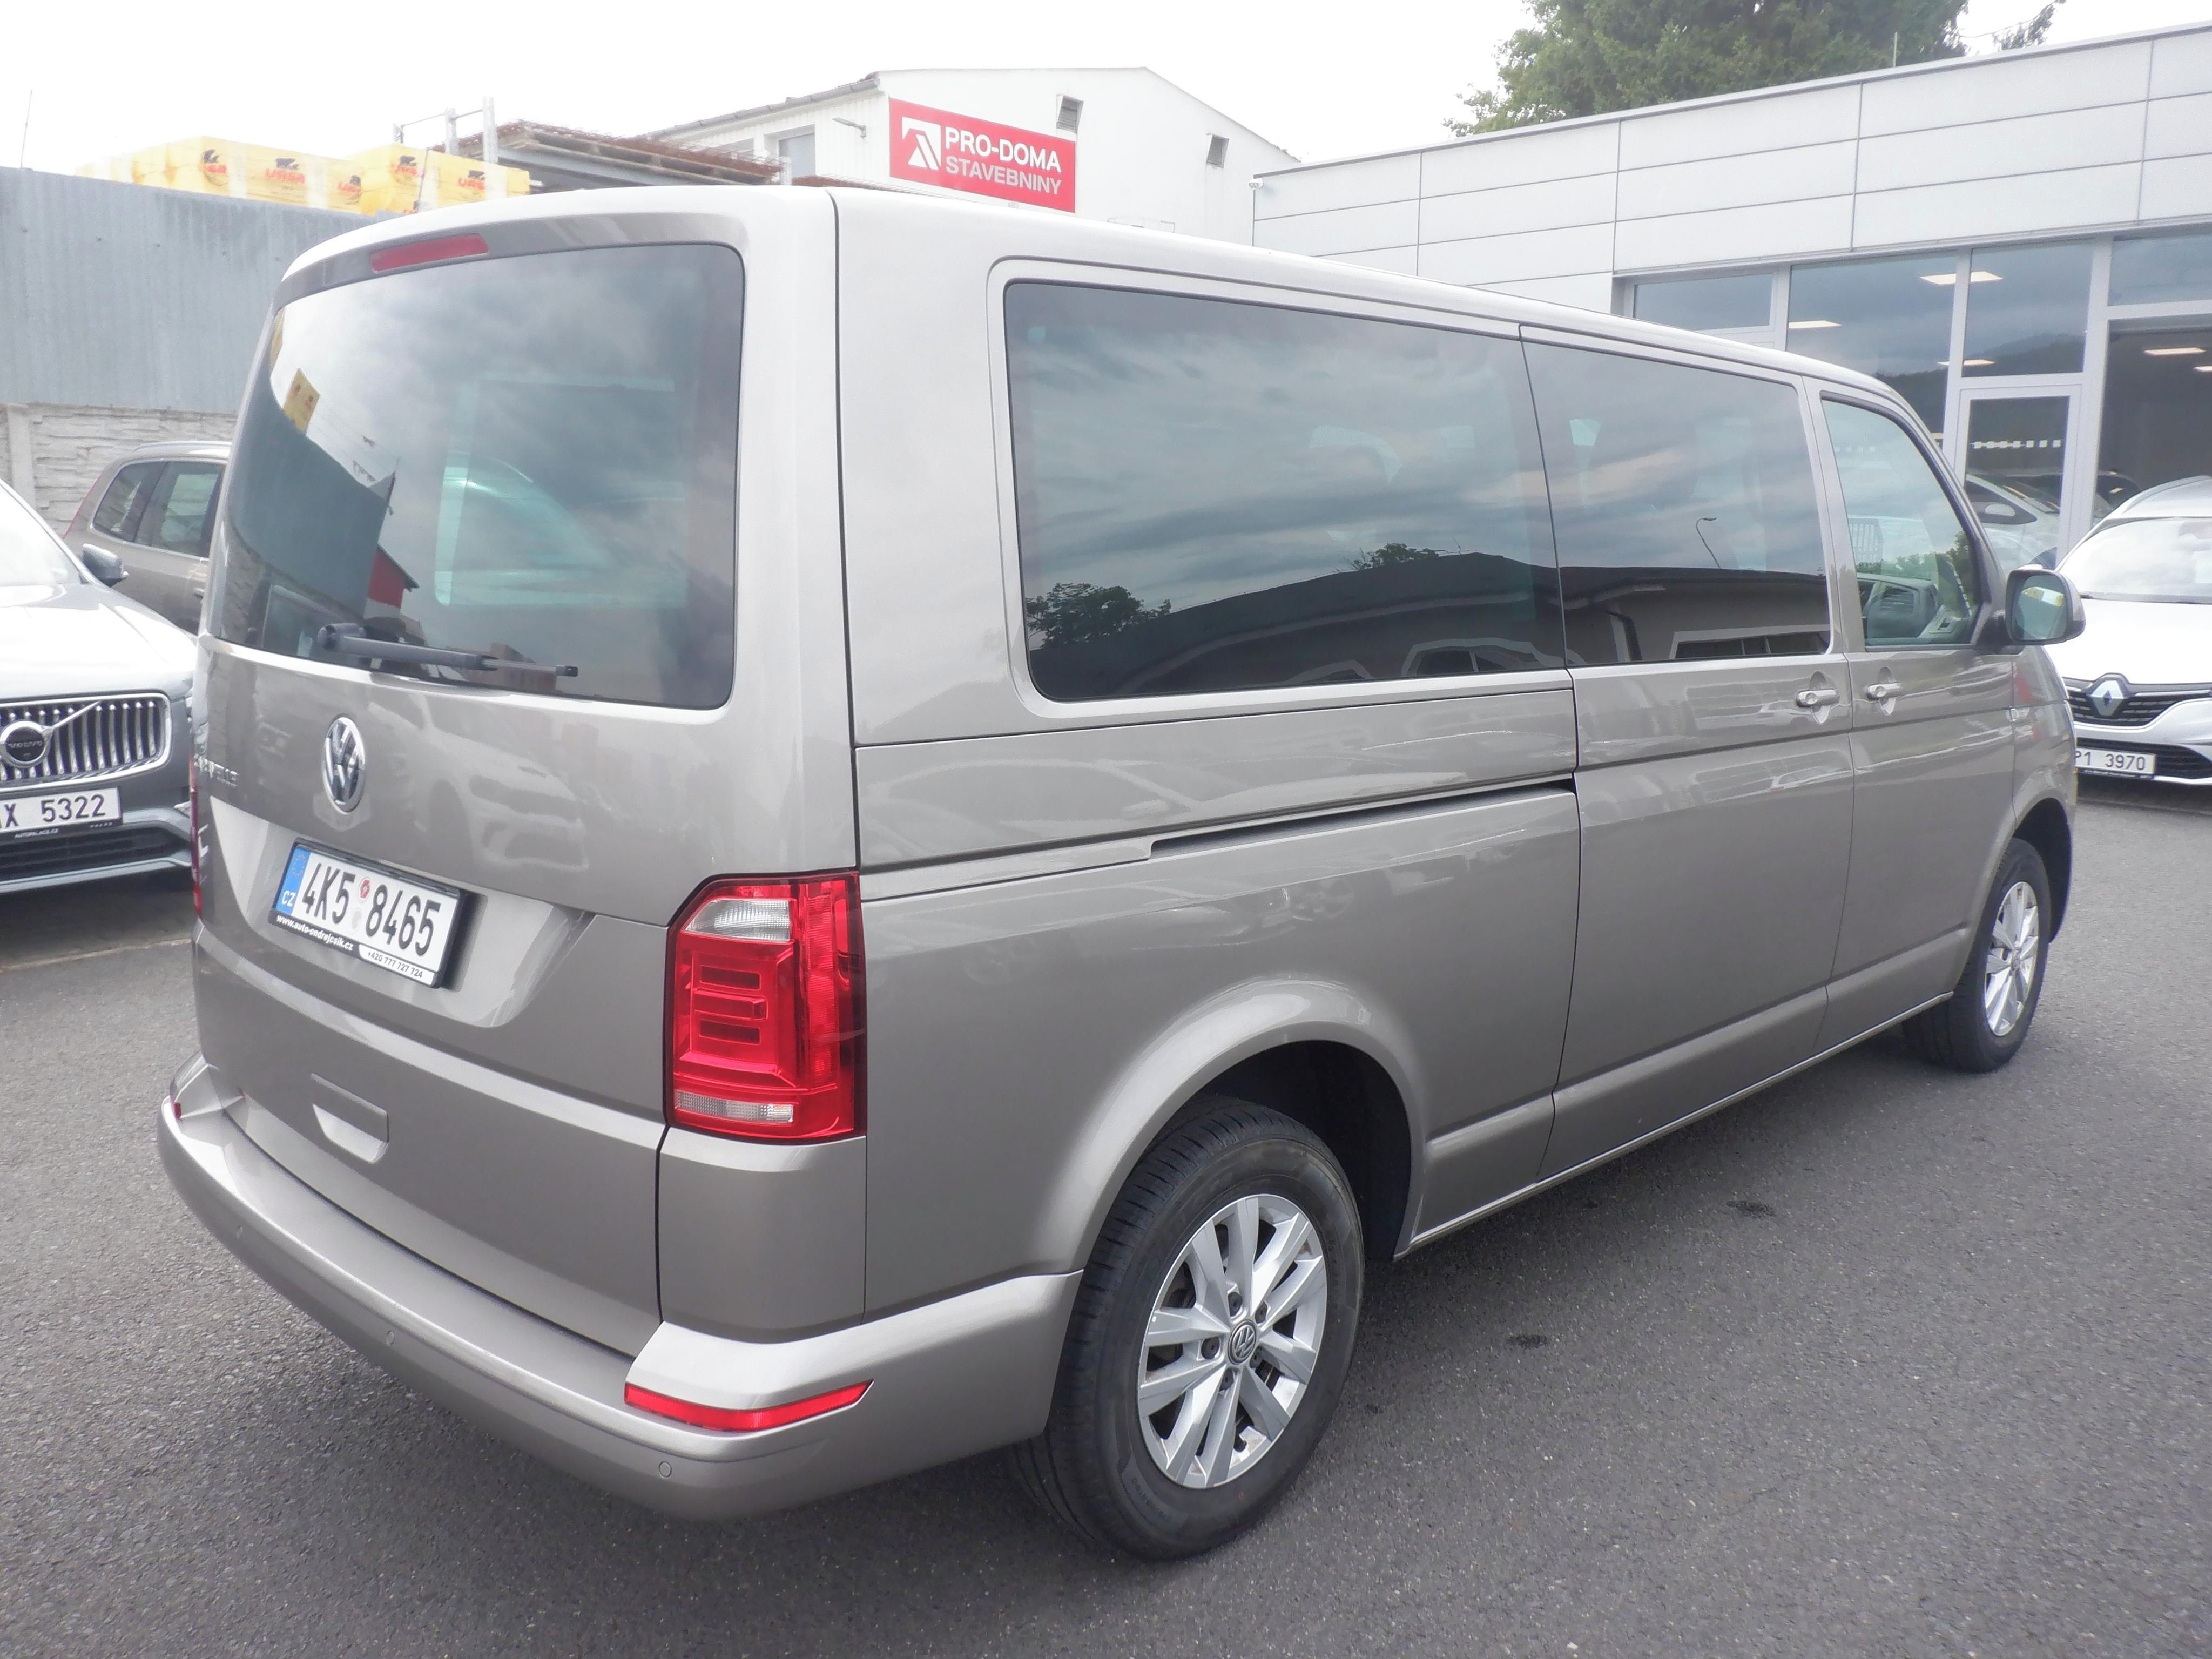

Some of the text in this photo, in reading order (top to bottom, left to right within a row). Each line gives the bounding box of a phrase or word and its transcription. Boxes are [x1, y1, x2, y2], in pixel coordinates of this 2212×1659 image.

[945, 126, 1062, 173] PRO-DOMA
[945, 156, 1062, 195] STAVEBNINY
[2105, 753, 2146, 771] 3970
[0, 793, 106, 828] X 5322
[281, 890, 296, 907] CZ
[302, 862, 442, 957] 4K5 8465
[368, 951, 423, 978] +420 777 727 724
